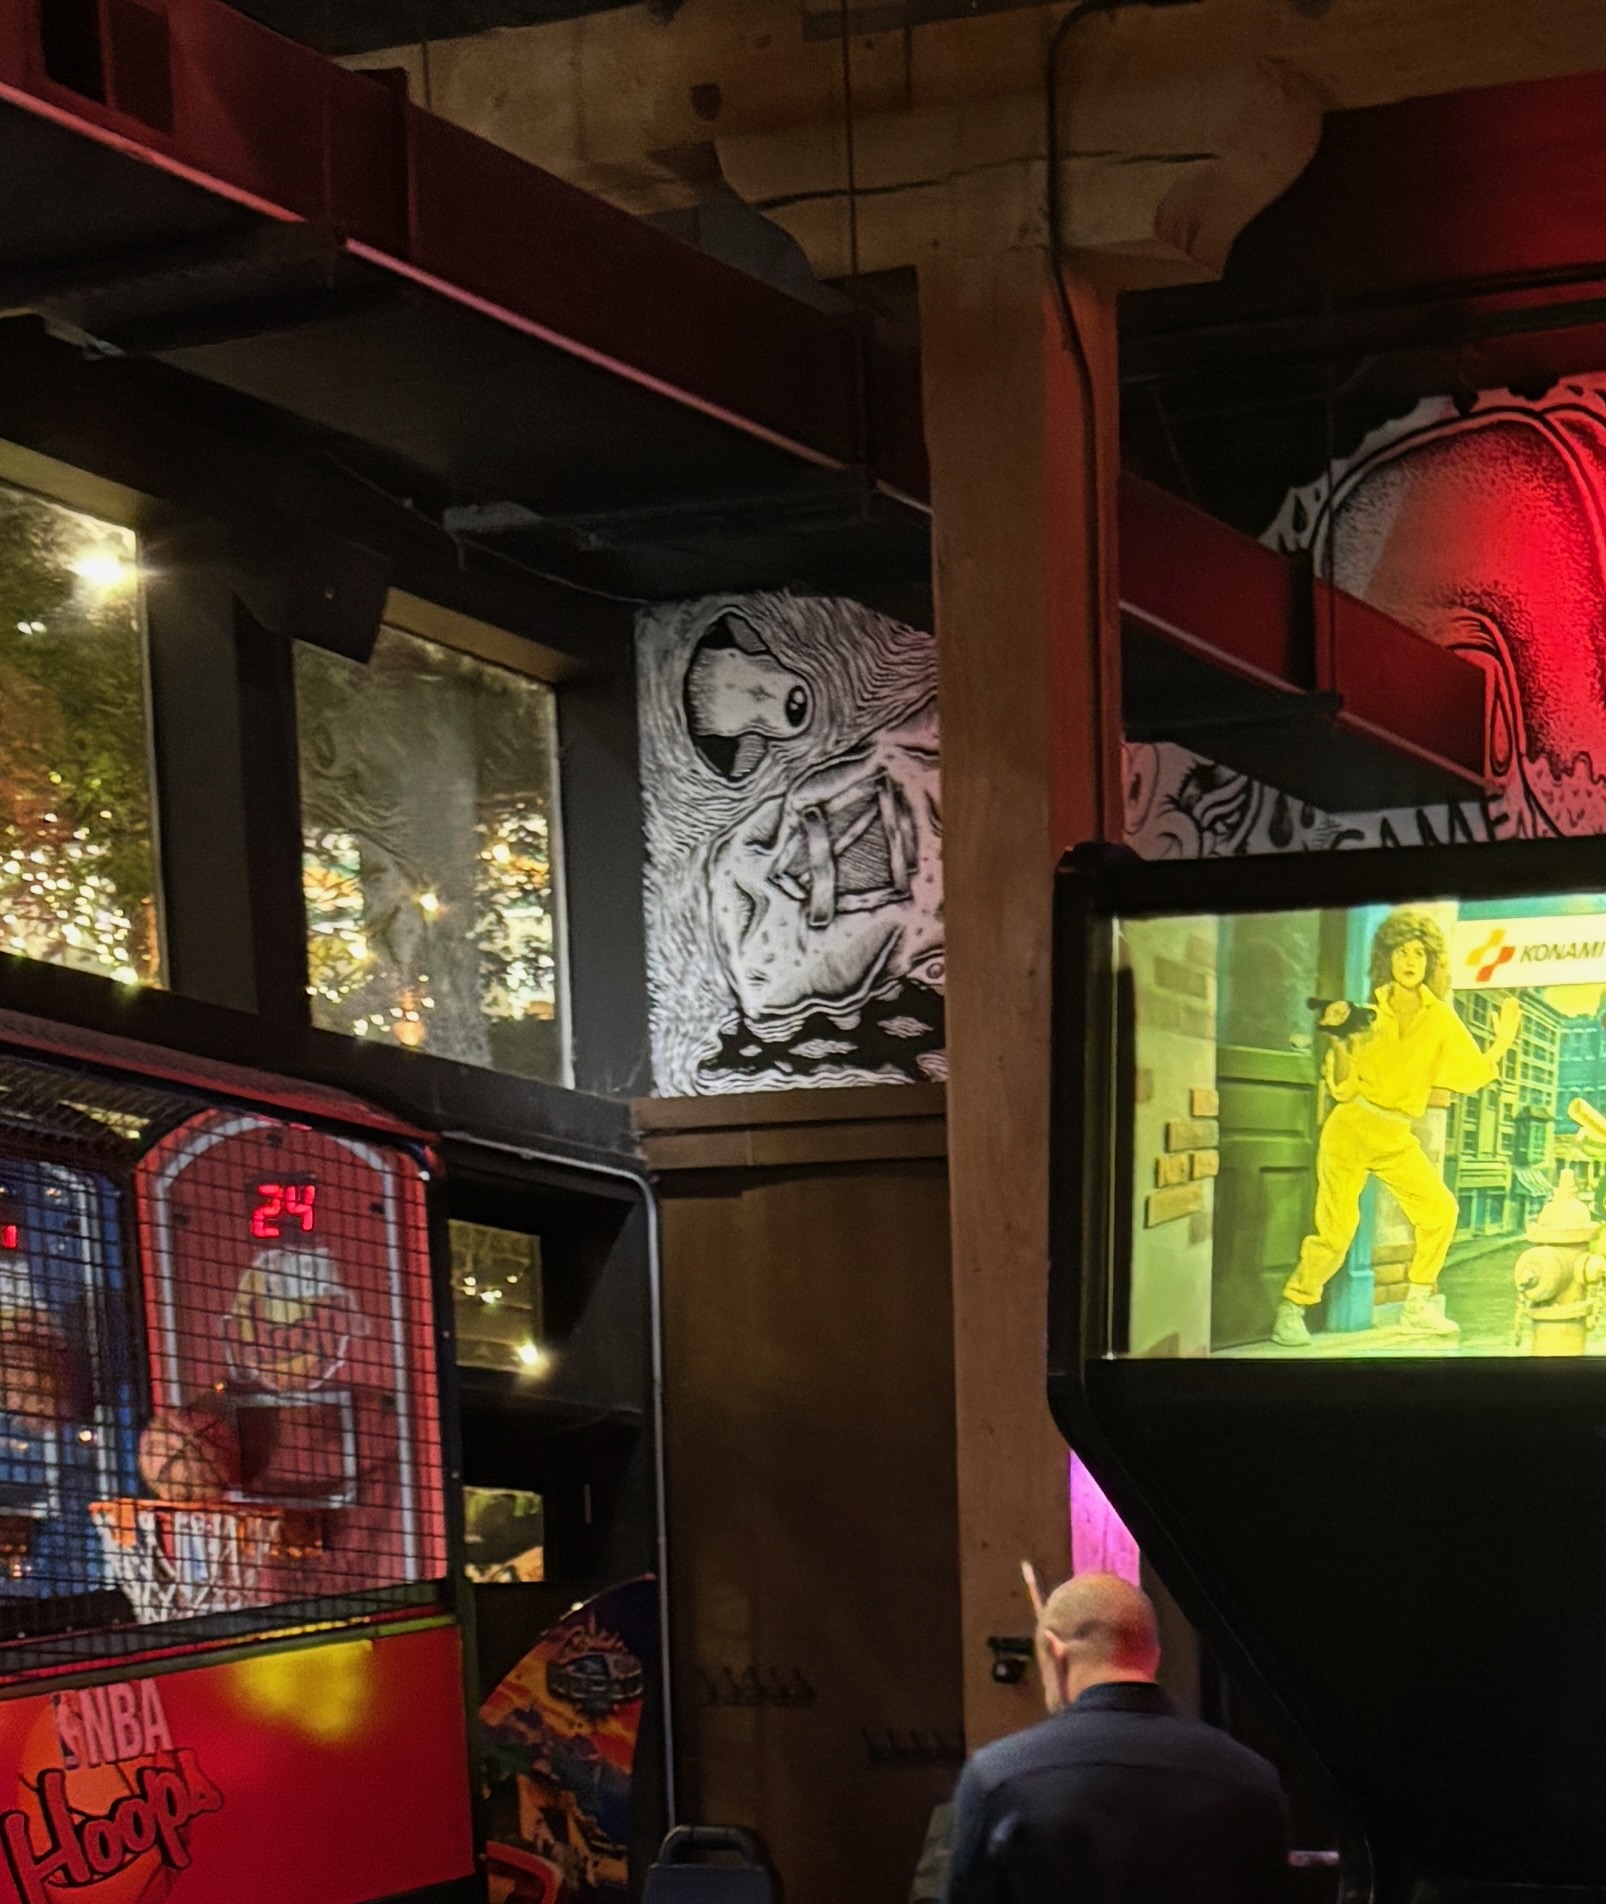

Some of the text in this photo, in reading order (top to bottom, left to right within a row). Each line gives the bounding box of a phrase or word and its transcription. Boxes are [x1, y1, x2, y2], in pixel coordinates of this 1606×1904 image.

[1520, 940, 1606, 965] KONAMI
[251, 1184, 316, 1238] 24
[79, 1678, 174, 1768] NBA
